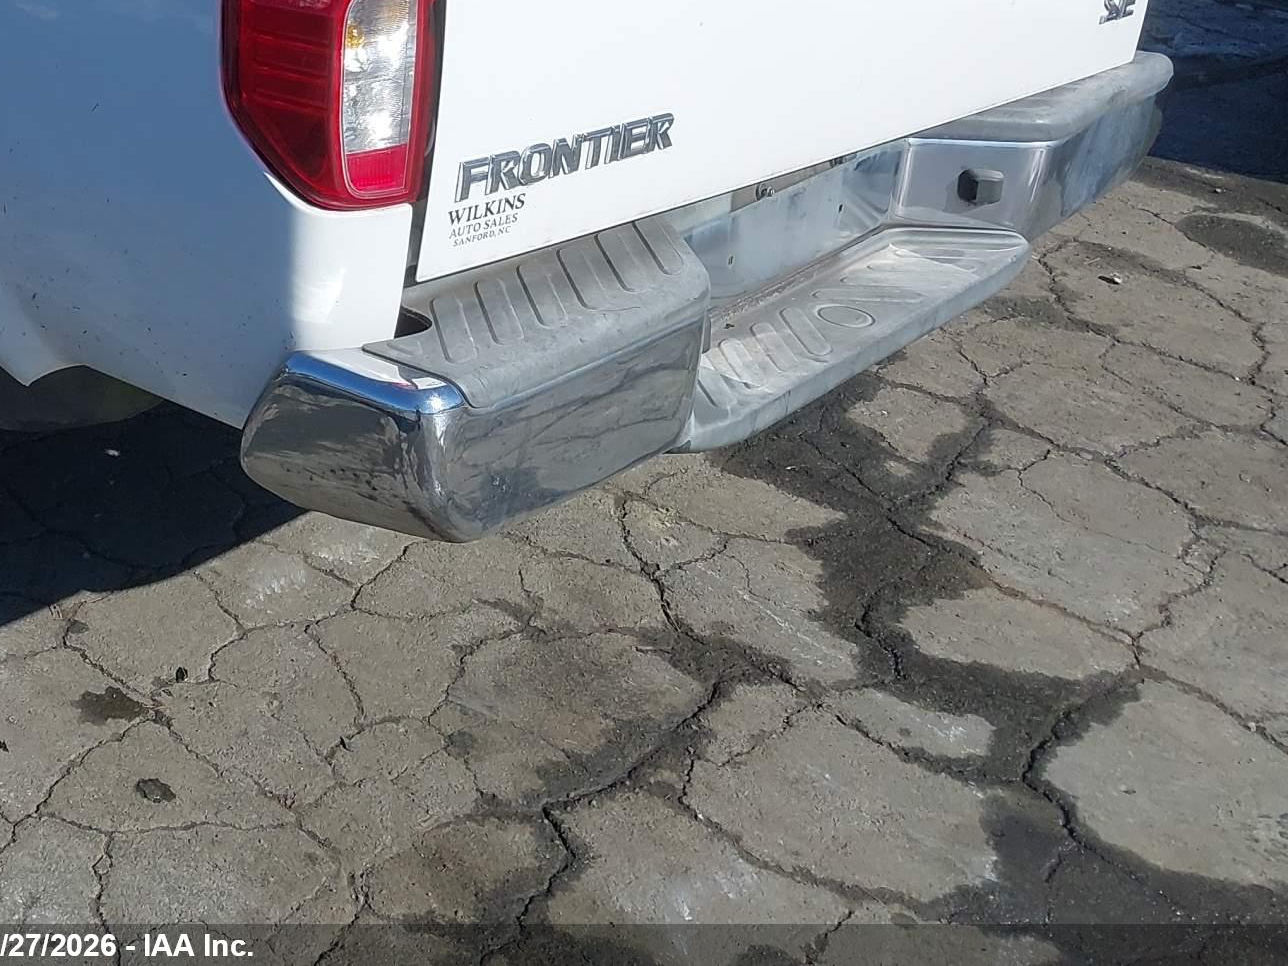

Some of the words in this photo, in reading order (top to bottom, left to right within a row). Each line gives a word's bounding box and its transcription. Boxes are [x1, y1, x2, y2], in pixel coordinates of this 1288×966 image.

[454, 113, 674, 202] FRONTIER
[448, 193, 526, 225] WILKINS
[449, 222, 481, 239] AUTO
[483, 212, 518, 230] SALES
[453, 230, 496, 247] SANFORD,
[497, 225, 511, 235] NC
